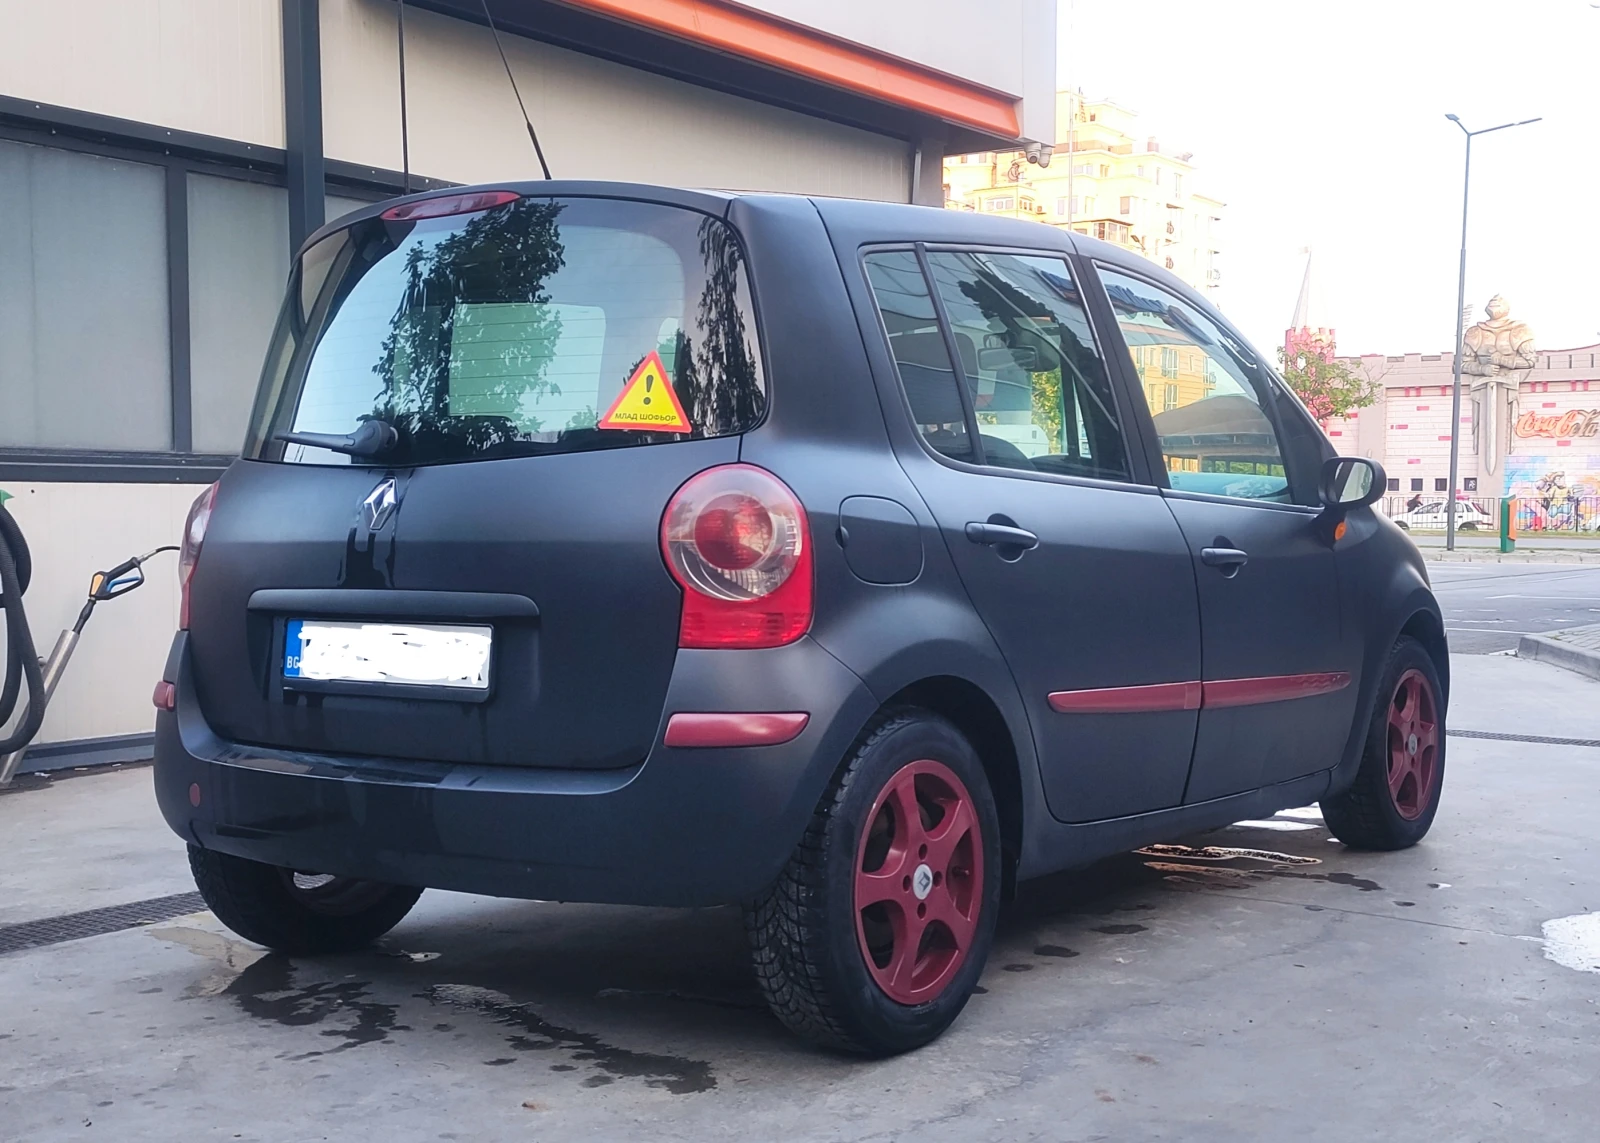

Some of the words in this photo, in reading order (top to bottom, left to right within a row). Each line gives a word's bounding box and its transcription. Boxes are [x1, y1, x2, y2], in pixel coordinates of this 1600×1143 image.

[615, 412, 638, 421] МЛАД
[640, 413, 677, 422] ШОФЬОР
[286, 655, 300, 669] BG
